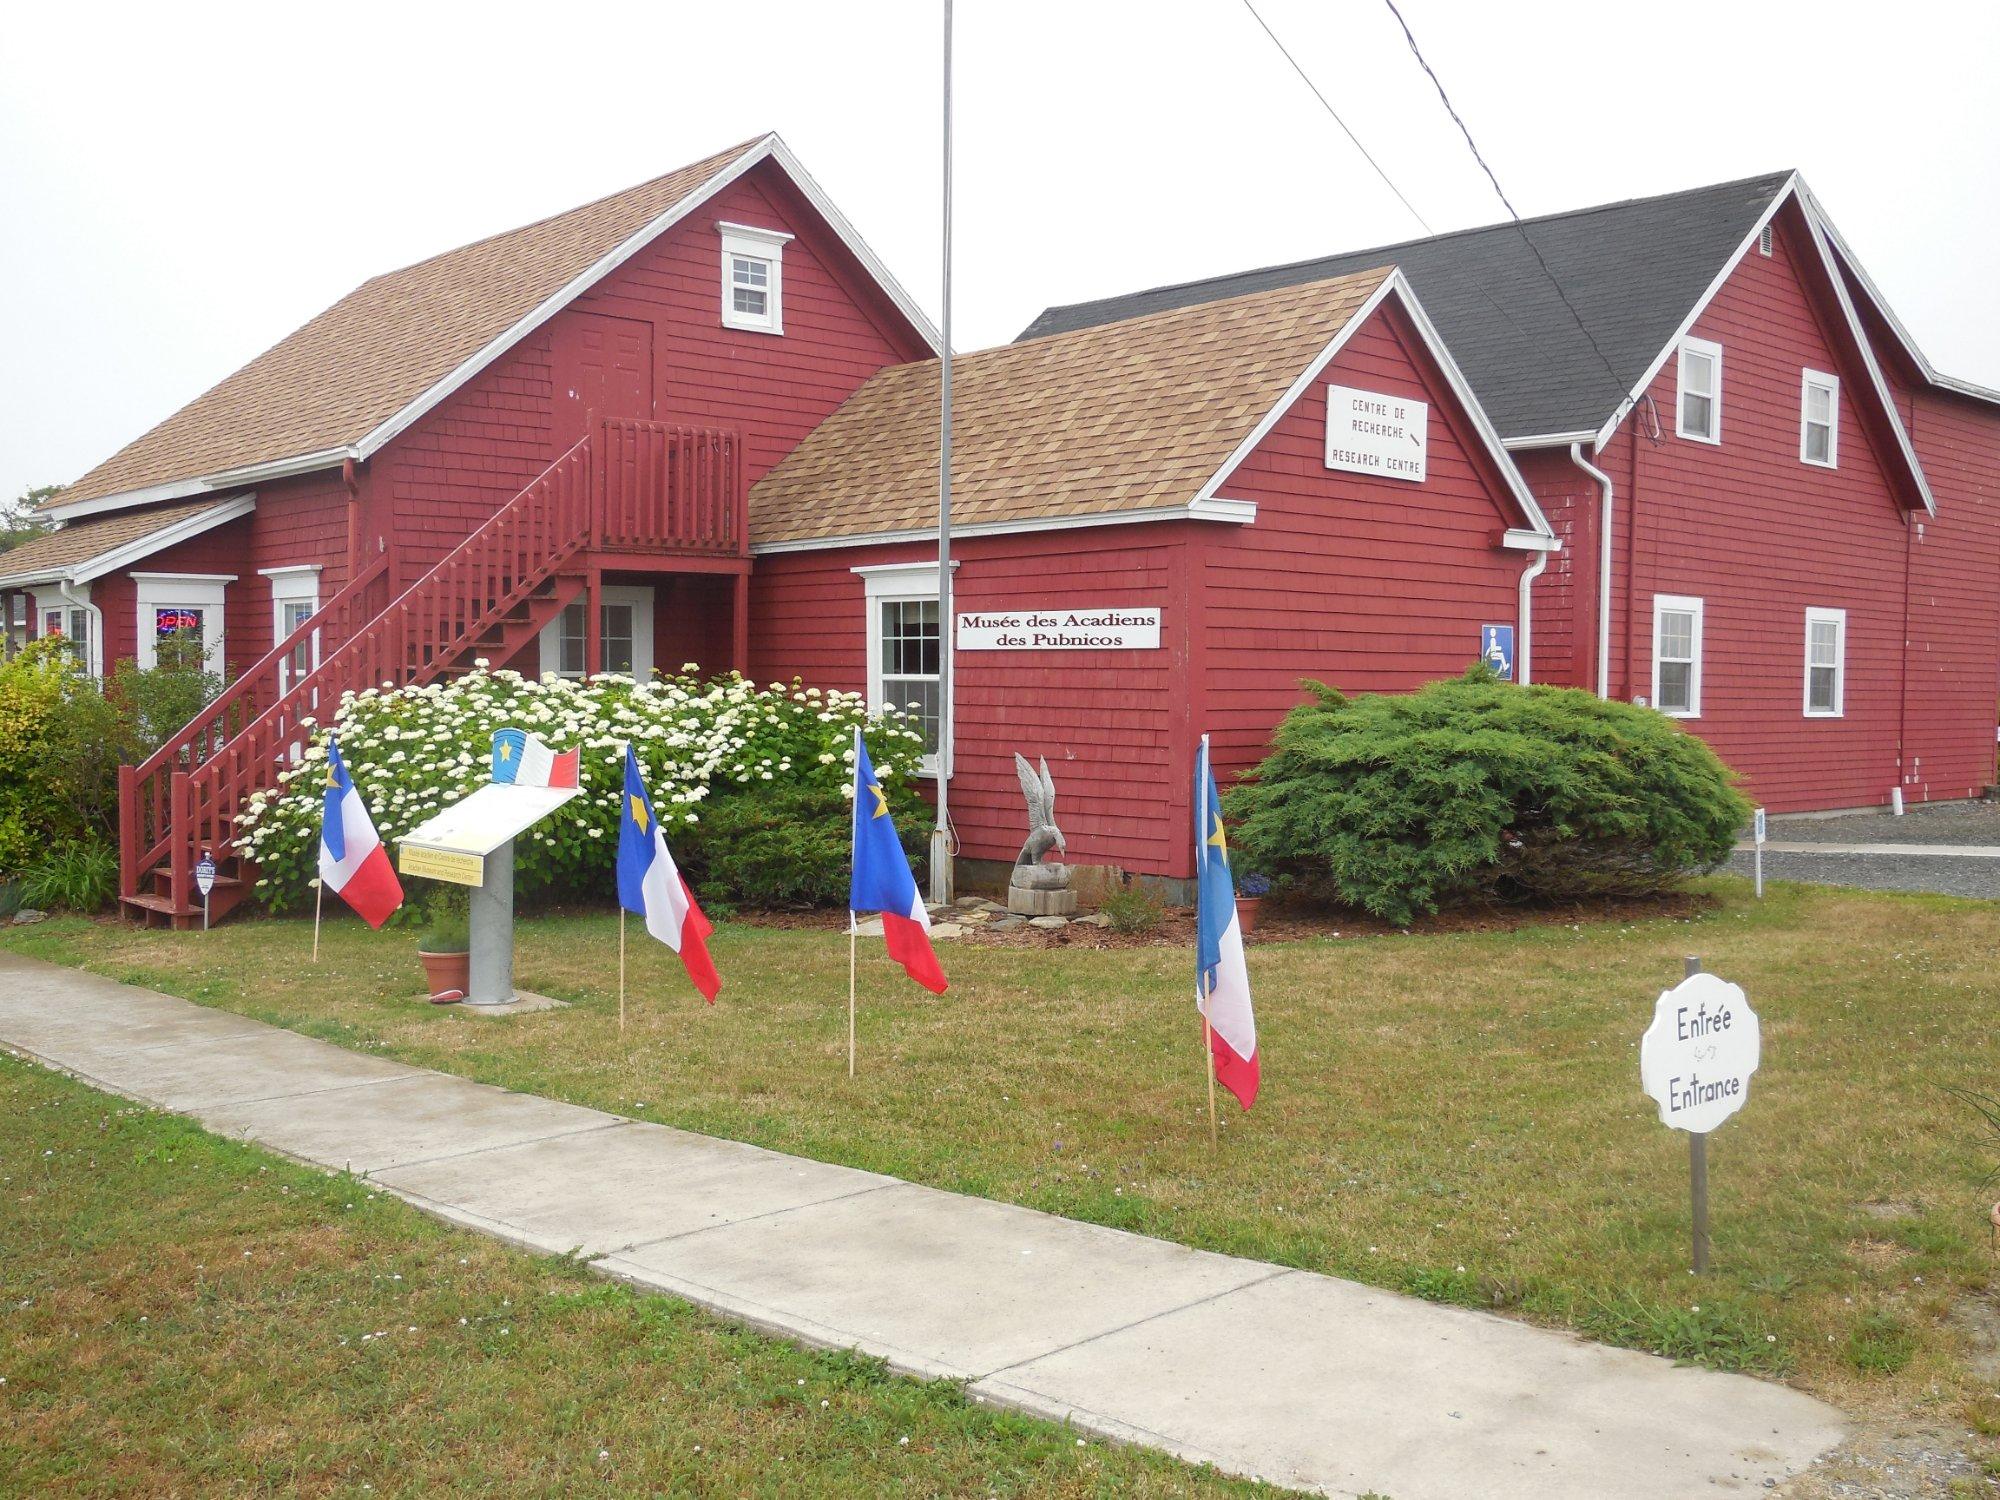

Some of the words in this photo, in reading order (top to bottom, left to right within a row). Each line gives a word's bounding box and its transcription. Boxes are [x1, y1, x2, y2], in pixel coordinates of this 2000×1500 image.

[1352, 399, 1387, 416] CENTRE
[1394, 407, 1405, 419] DE
[1352, 419, 1403, 439] RECHERCHE
[1332, 449, 1380, 467] RESEARCH
[1387, 457, 1420, 474] CENTRE
[157, 616, 197, 628] OPEN
[961, 614, 1021, 629] Musée
[1026, 614, 1058, 628] des
[1062, 613, 1156, 627] Acadiens
[996, 633, 1027, 647] des
[1031, 632, 1123, 646] Pubnicos
[1677, 1002, 1732, 1042] Entrée
[1669, 1073, 1740, 1113] Entrance
